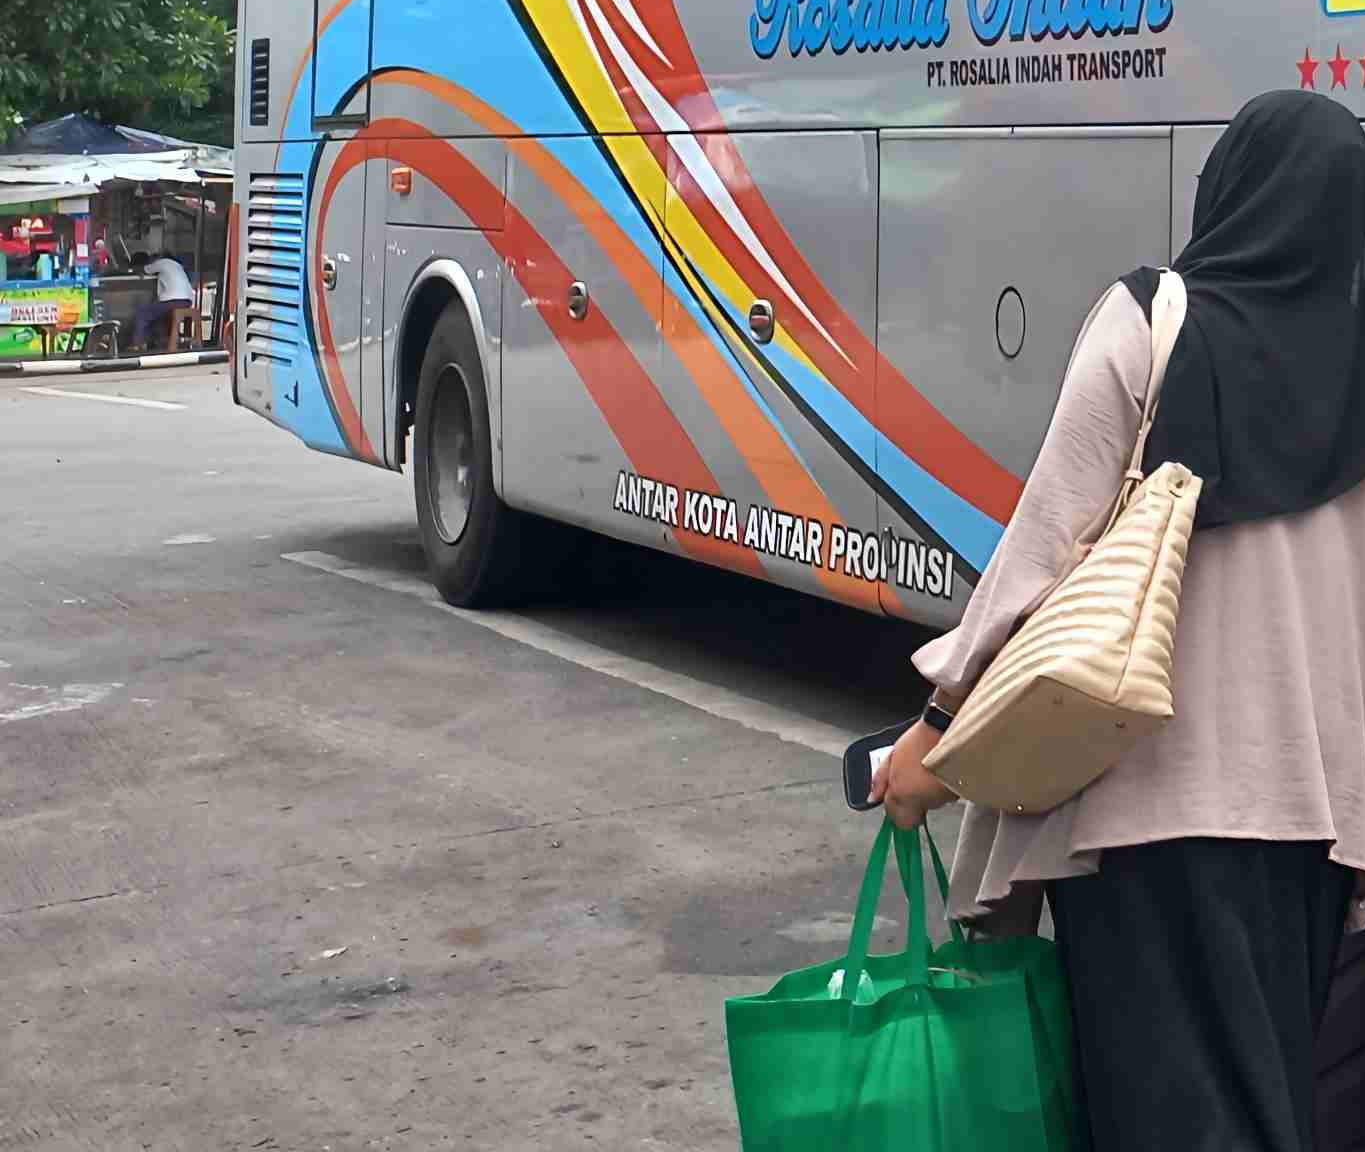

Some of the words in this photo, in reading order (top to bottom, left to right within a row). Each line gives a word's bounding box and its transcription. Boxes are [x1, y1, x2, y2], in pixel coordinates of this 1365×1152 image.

[927, 60, 947, 87] PT.
[949, 54, 1012, 87] ROSALIA
[1014, 52, 1063, 85] INDAH
[1067, 47, 1167, 81] TRANSPORT
[613, 470, 680, 526] ANTAR
[683, 489, 739, 545] KOTA
[744, 504, 823, 567] ANTAR
